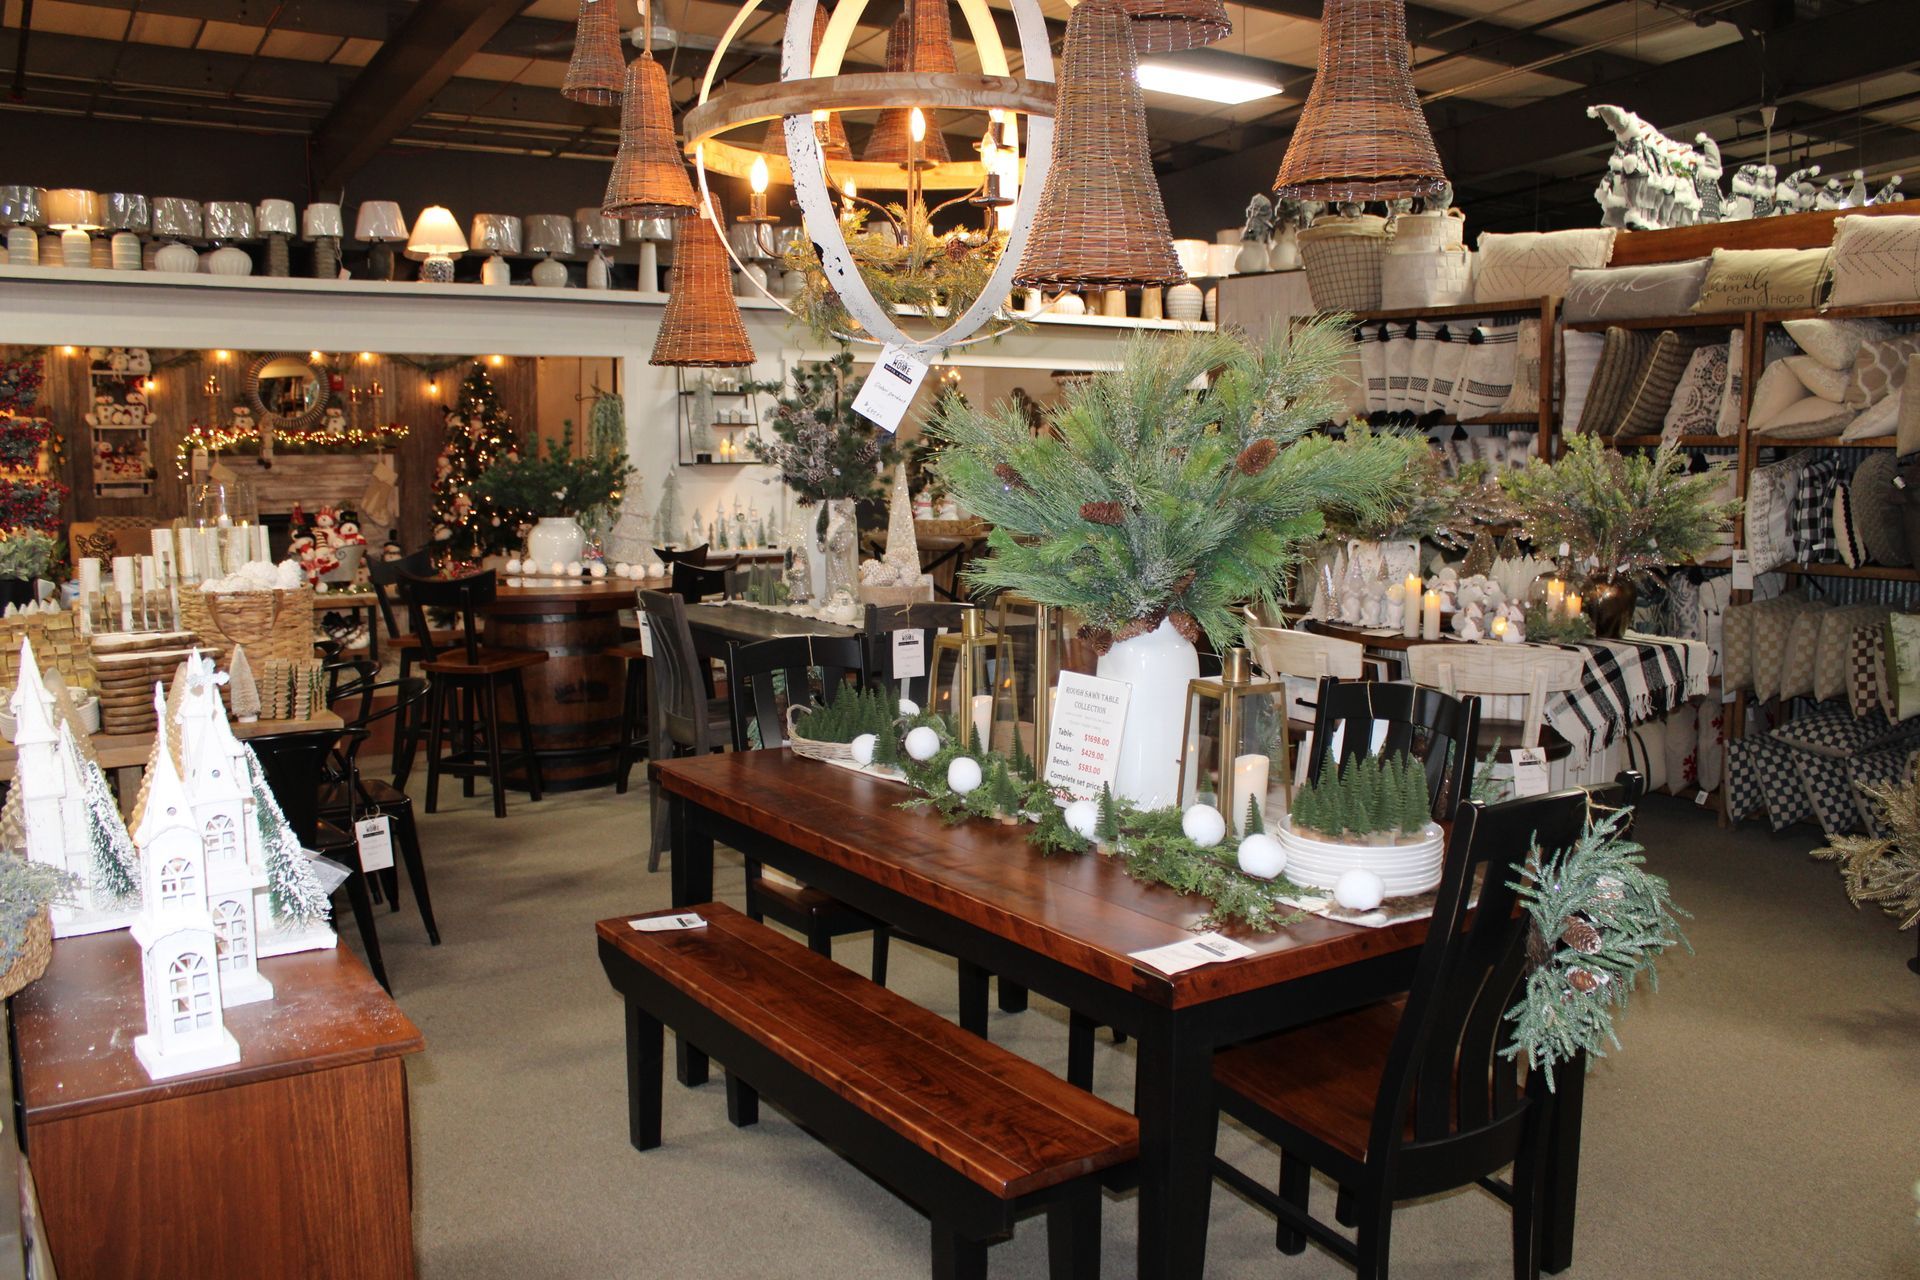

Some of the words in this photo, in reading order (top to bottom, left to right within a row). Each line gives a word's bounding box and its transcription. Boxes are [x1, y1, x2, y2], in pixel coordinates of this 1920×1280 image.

[1711, 265, 1771, 306] amily
[1726, 294, 1755, 306] Faith
[1770, 293, 1805, 305] Hope
[892, 359, 912, 376] HOME
[1066, 686, 1084, 697] ROUGH
[1101, 693, 1120, 704] TABLE
[1074, 700, 1106, 715] COLLECTION
[1084, 733, 1110, 747] $1698.00
[1081, 748, 1105, 760] $429.00
[1078, 763, 1101, 775] $583.00
[1050, 770, 1076, 784] Complete
[1077, 779, 1086, 788] set
